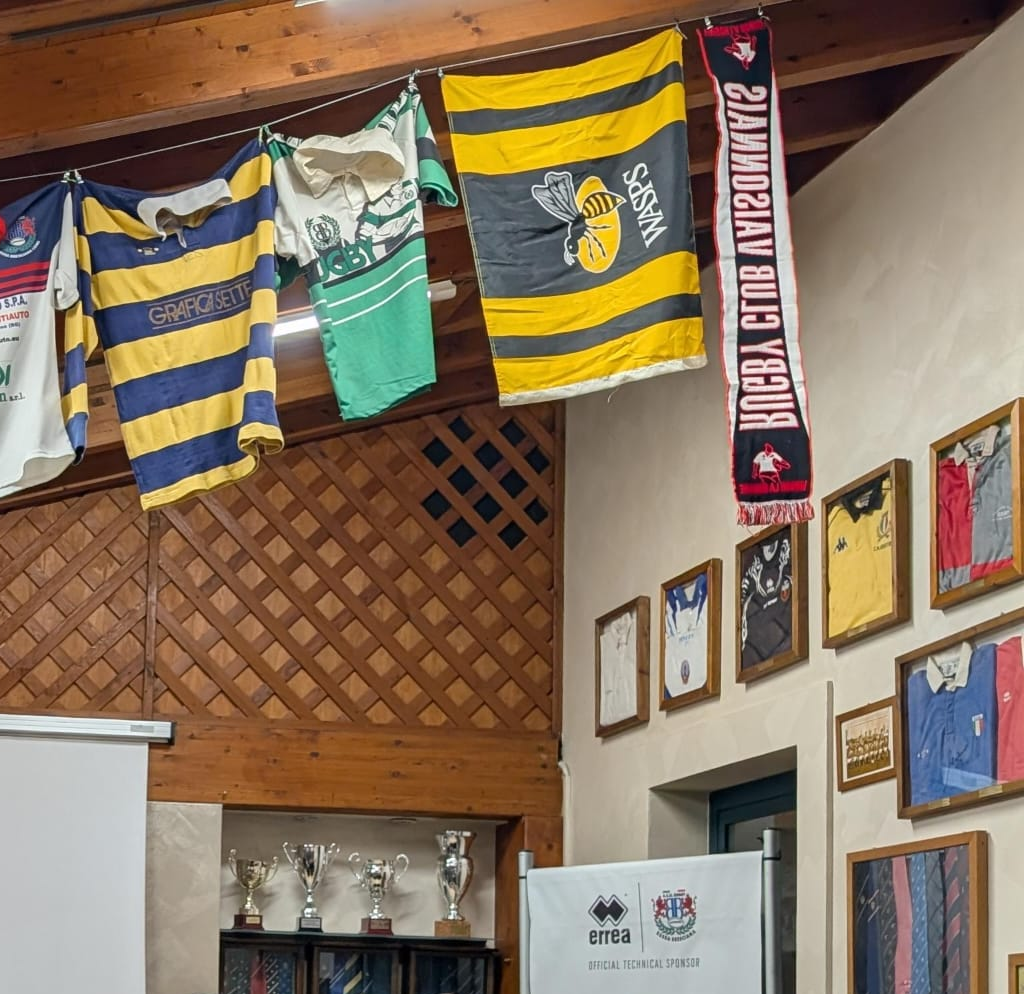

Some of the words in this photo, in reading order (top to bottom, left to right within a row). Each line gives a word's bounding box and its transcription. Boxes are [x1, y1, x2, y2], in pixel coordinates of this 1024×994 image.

[622, 162, 669, 249] WASPS
[4, 294, 28, 309] S.P.A.
[588, 928, 631, 946] errea
[588, 960, 621, 971] OFFICIAL
[623, 958, 664, 970] TECHNICAL
[666, 957, 700, 969] SPONSOR
